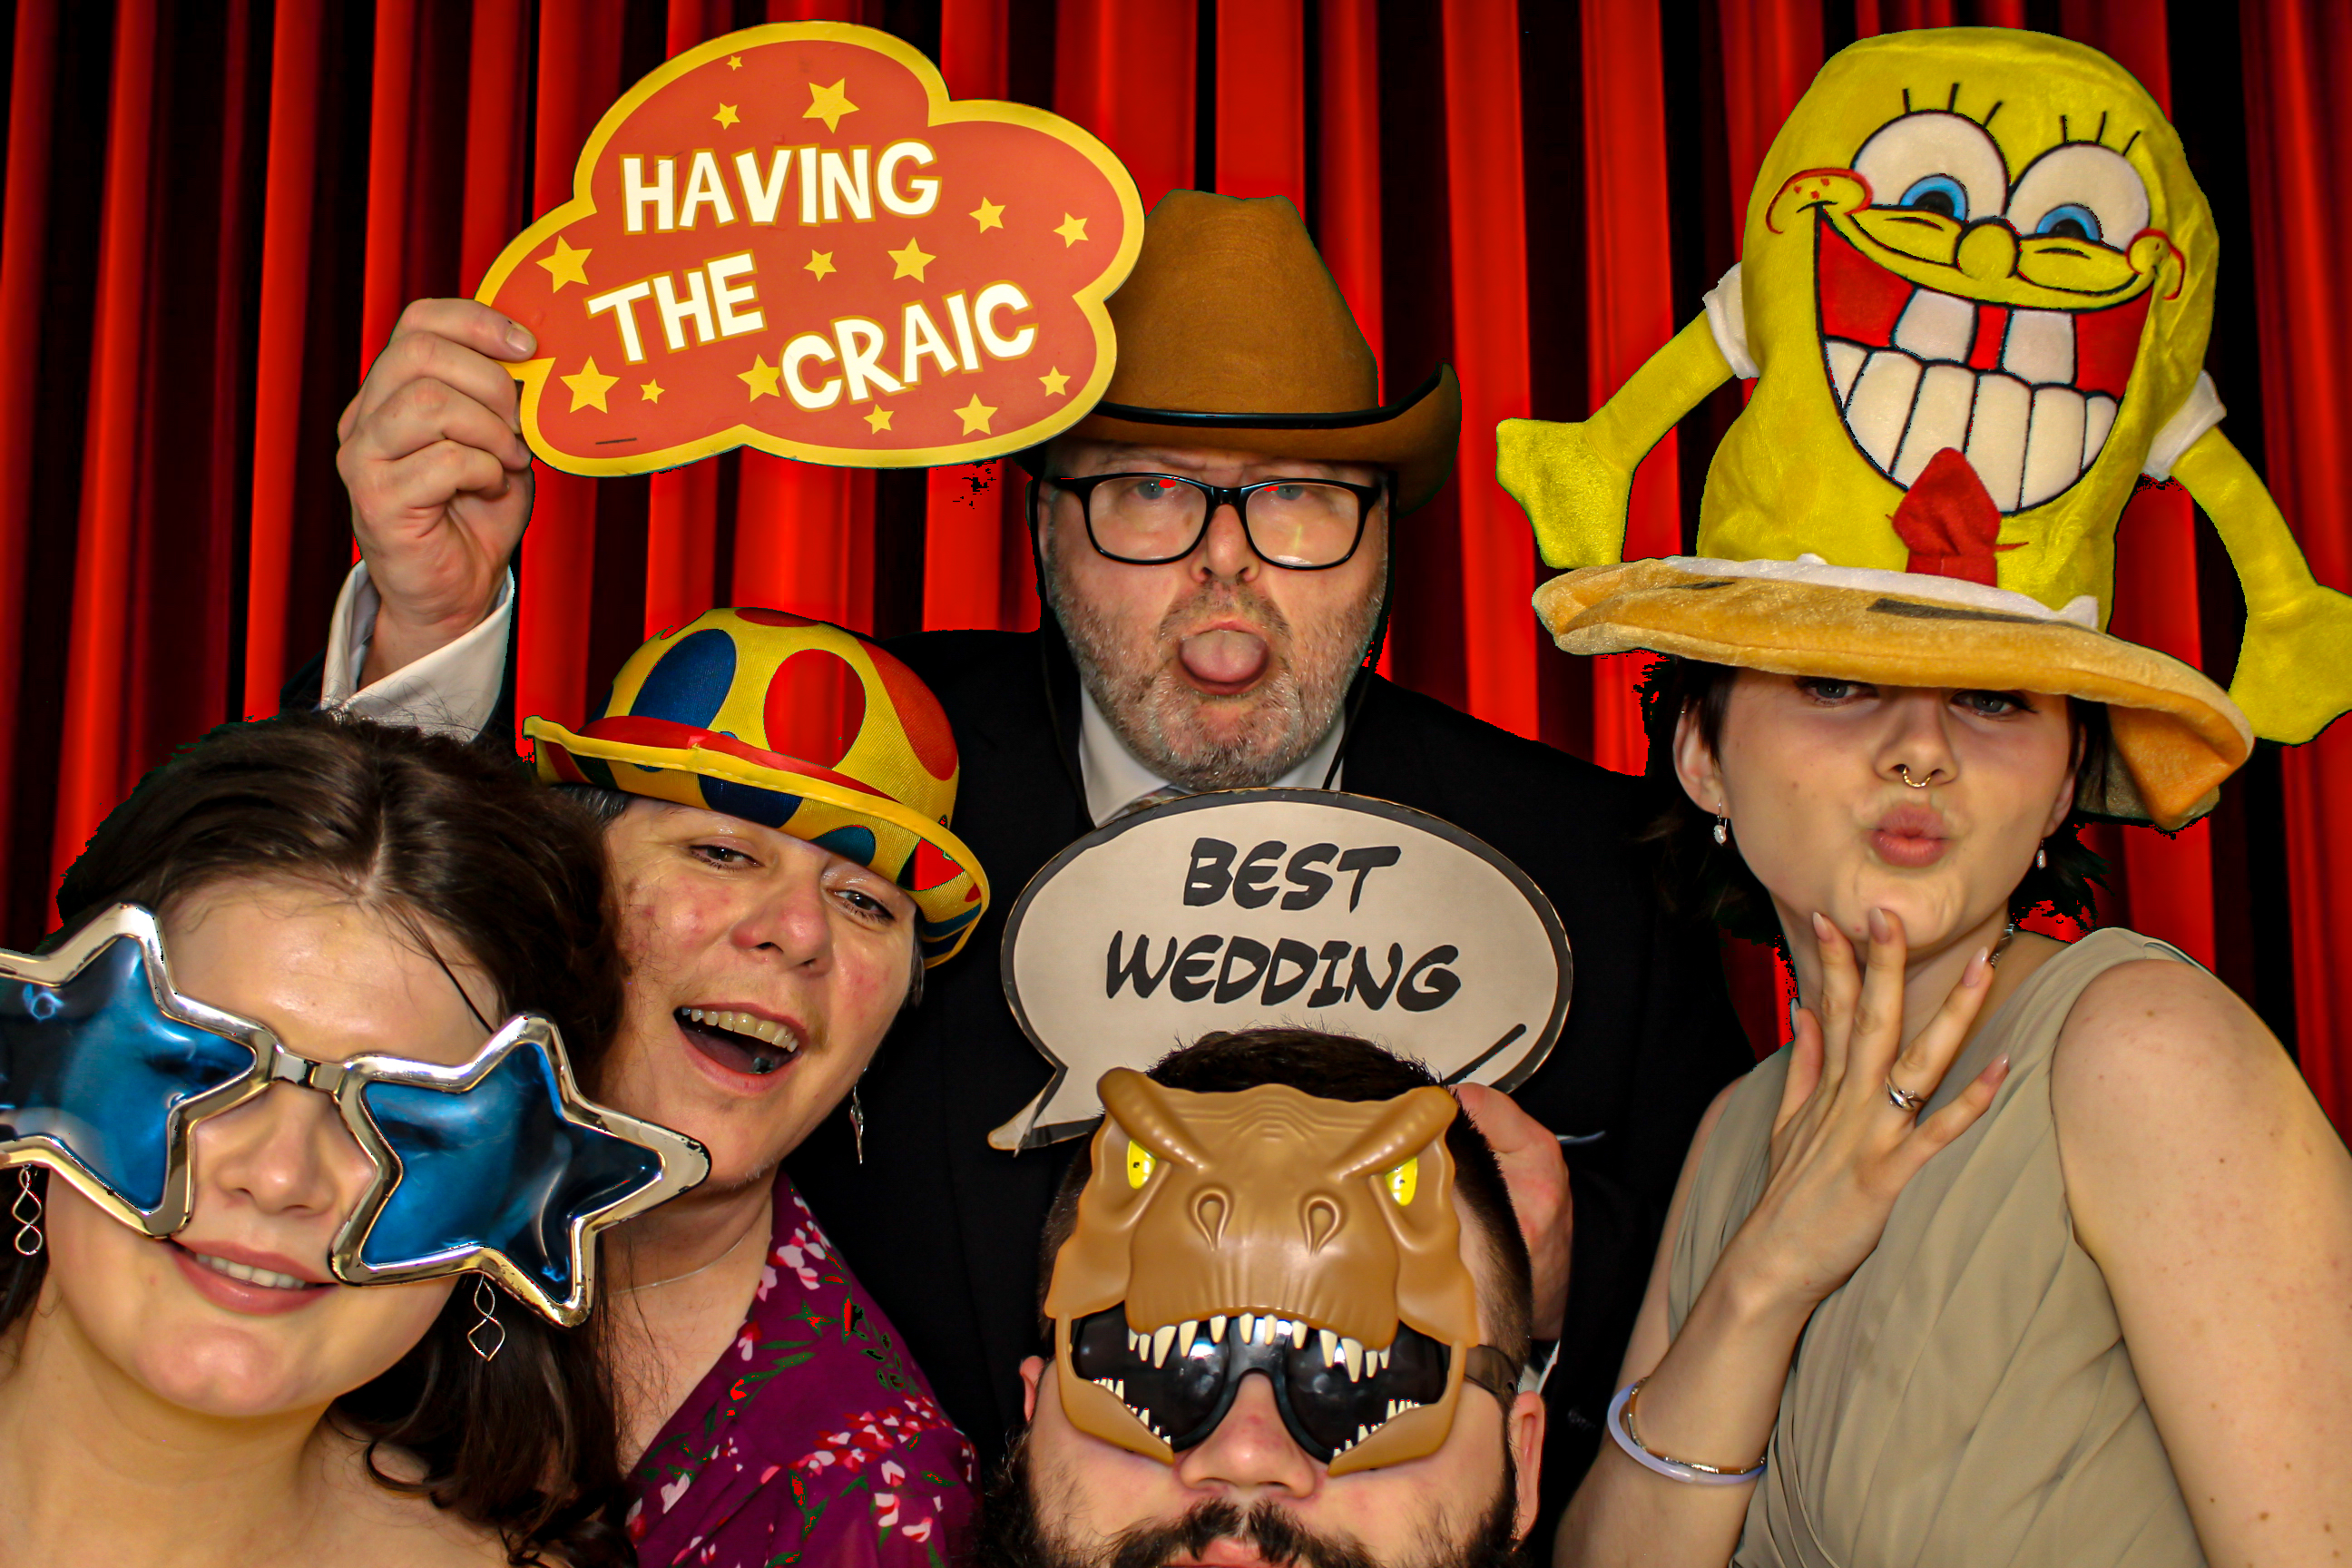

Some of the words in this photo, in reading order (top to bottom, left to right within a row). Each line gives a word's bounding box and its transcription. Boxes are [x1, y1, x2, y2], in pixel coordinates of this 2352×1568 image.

[624, 142, 937, 230] HAVING
[589, 254, 763, 361] THE
[783, 284, 1034, 408] CRAIC
[1183, 838, 1401, 913] BEST
[1106, 930, 1461, 1012] WEDDING
